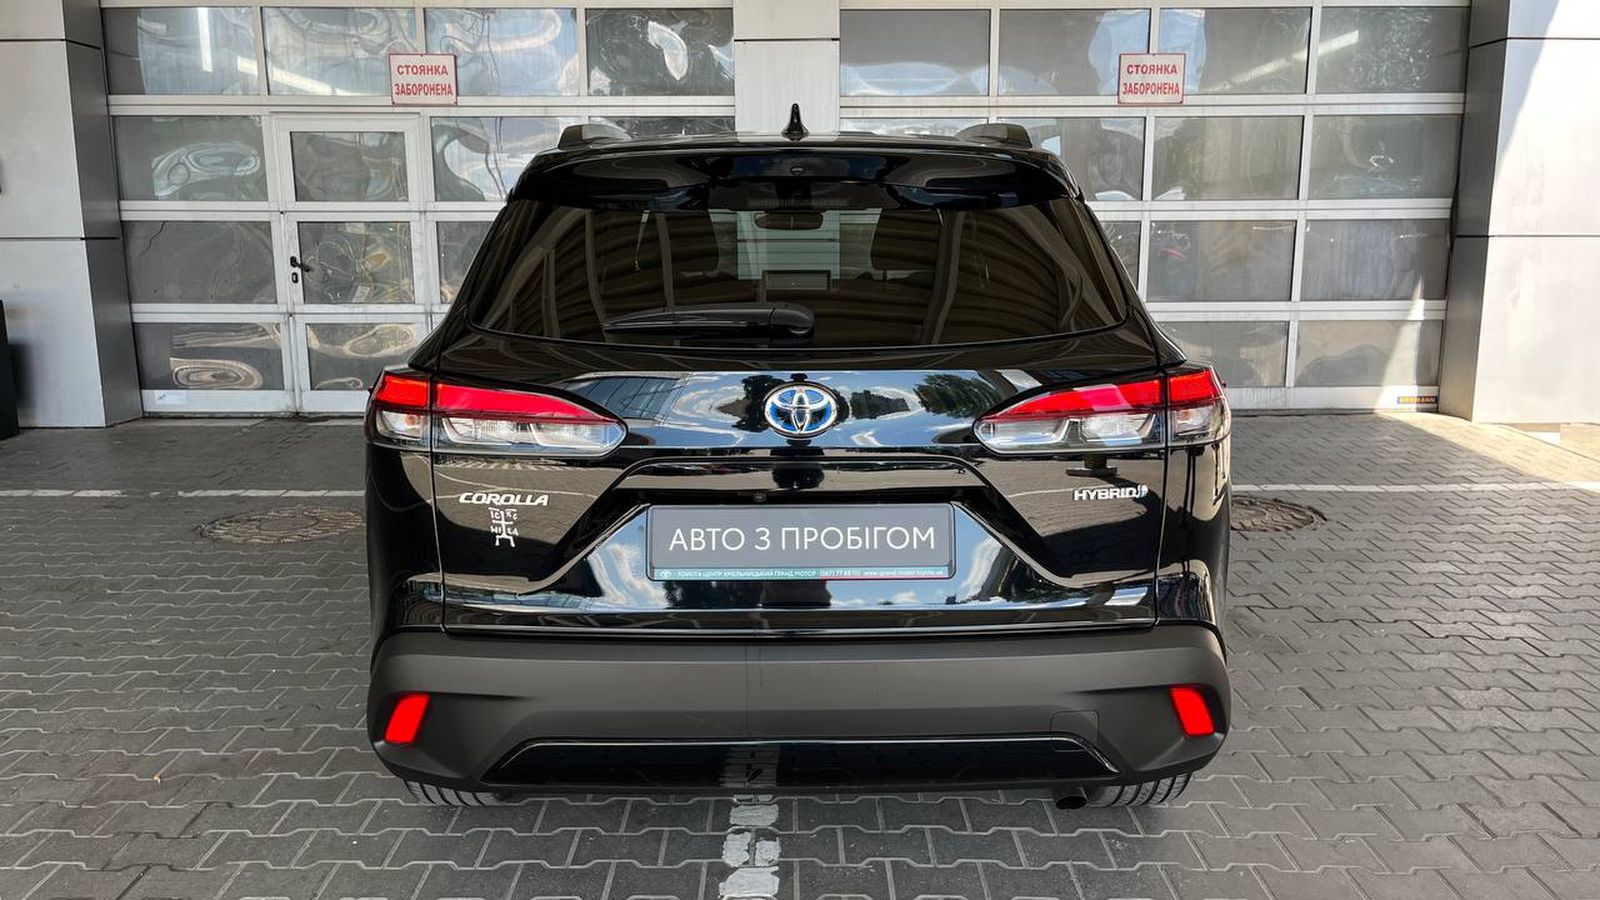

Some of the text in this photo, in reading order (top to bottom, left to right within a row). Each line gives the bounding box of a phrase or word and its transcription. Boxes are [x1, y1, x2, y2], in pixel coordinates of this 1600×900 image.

[397, 64, 449, 76] СТОЯНКА
[1126, 64, 1178, 75] СТОЯНКА
[394, 83, 454, 96] ЗАБОРОНЕНА
[1122, 82, 1181, 95] ЗАБОРОНЕНА
[459, 491, 549, 506] COROLLA
[1074, 487, 1138, 500] HYBRID
[668, 526, 935, 551] АВТО З ПРОБІГОМ
